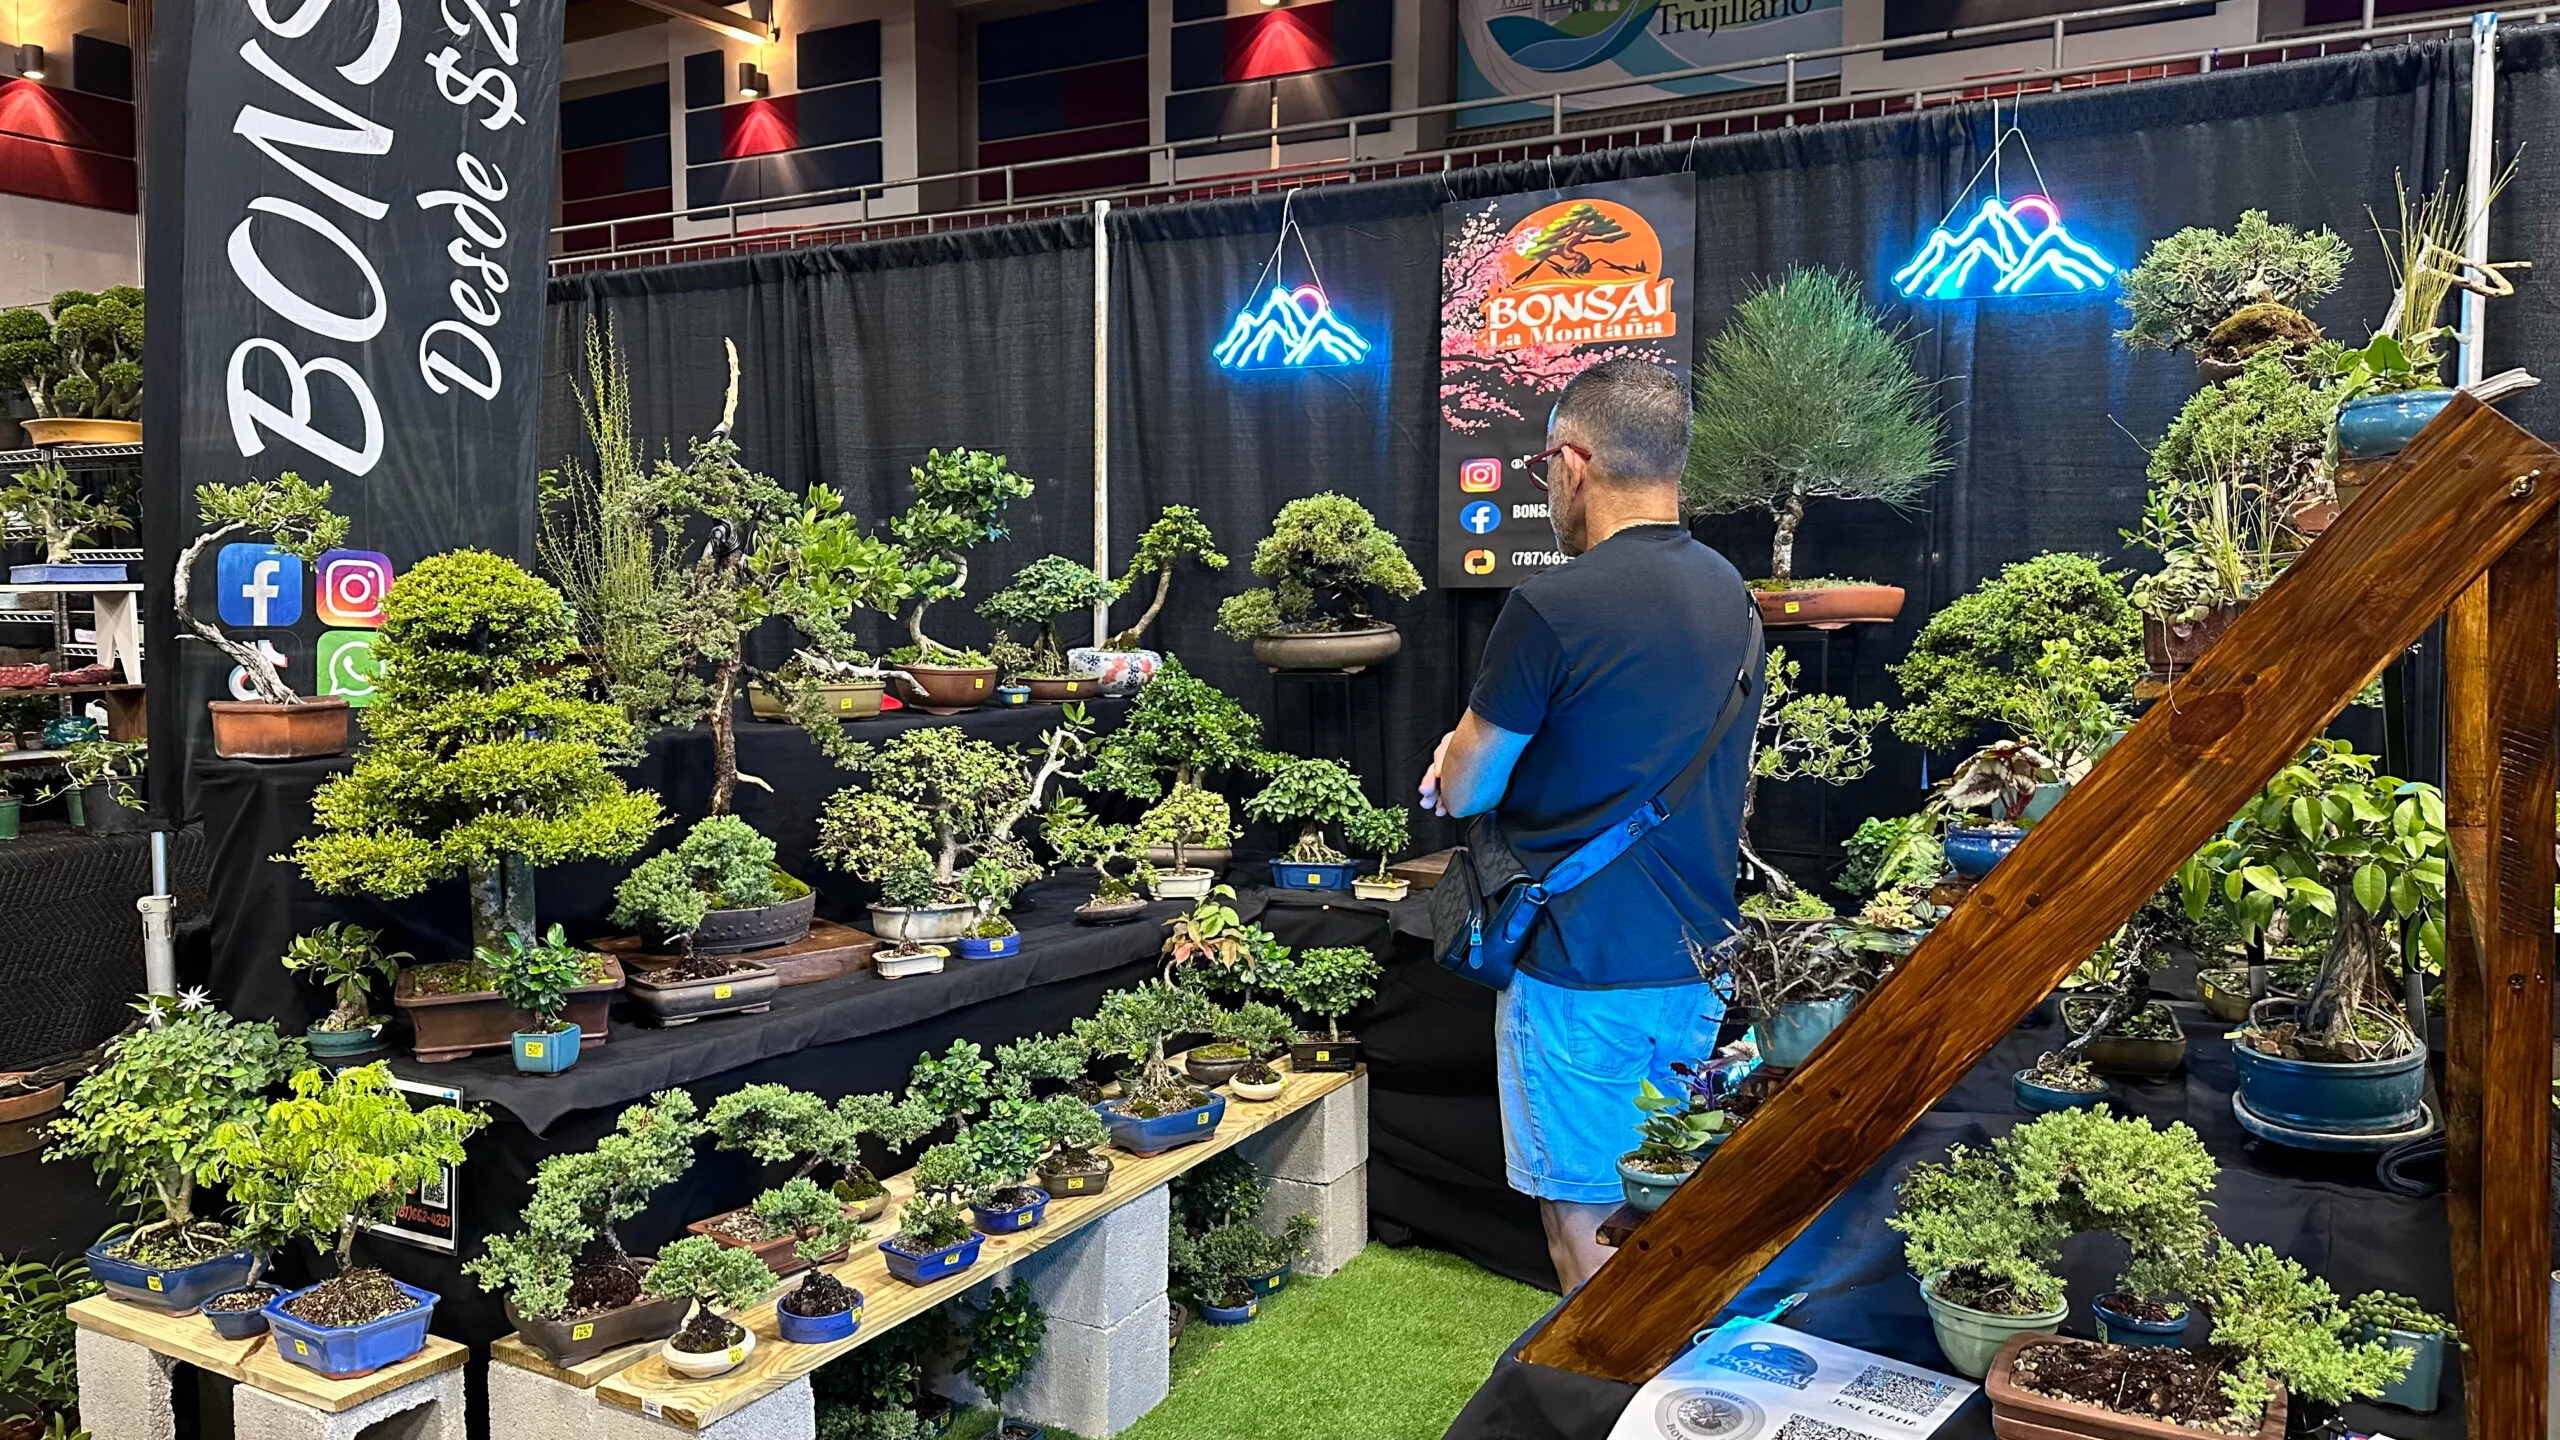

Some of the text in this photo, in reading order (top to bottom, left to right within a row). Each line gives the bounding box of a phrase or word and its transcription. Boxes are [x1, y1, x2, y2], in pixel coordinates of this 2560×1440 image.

[416, 0, 527, 401] Desde $2
[1484, 279, 1668, 331] BONSAI
[1488, 316, 1664, 347] La Montaña
[1719, 1353, 1816, 1386] BONSAI
